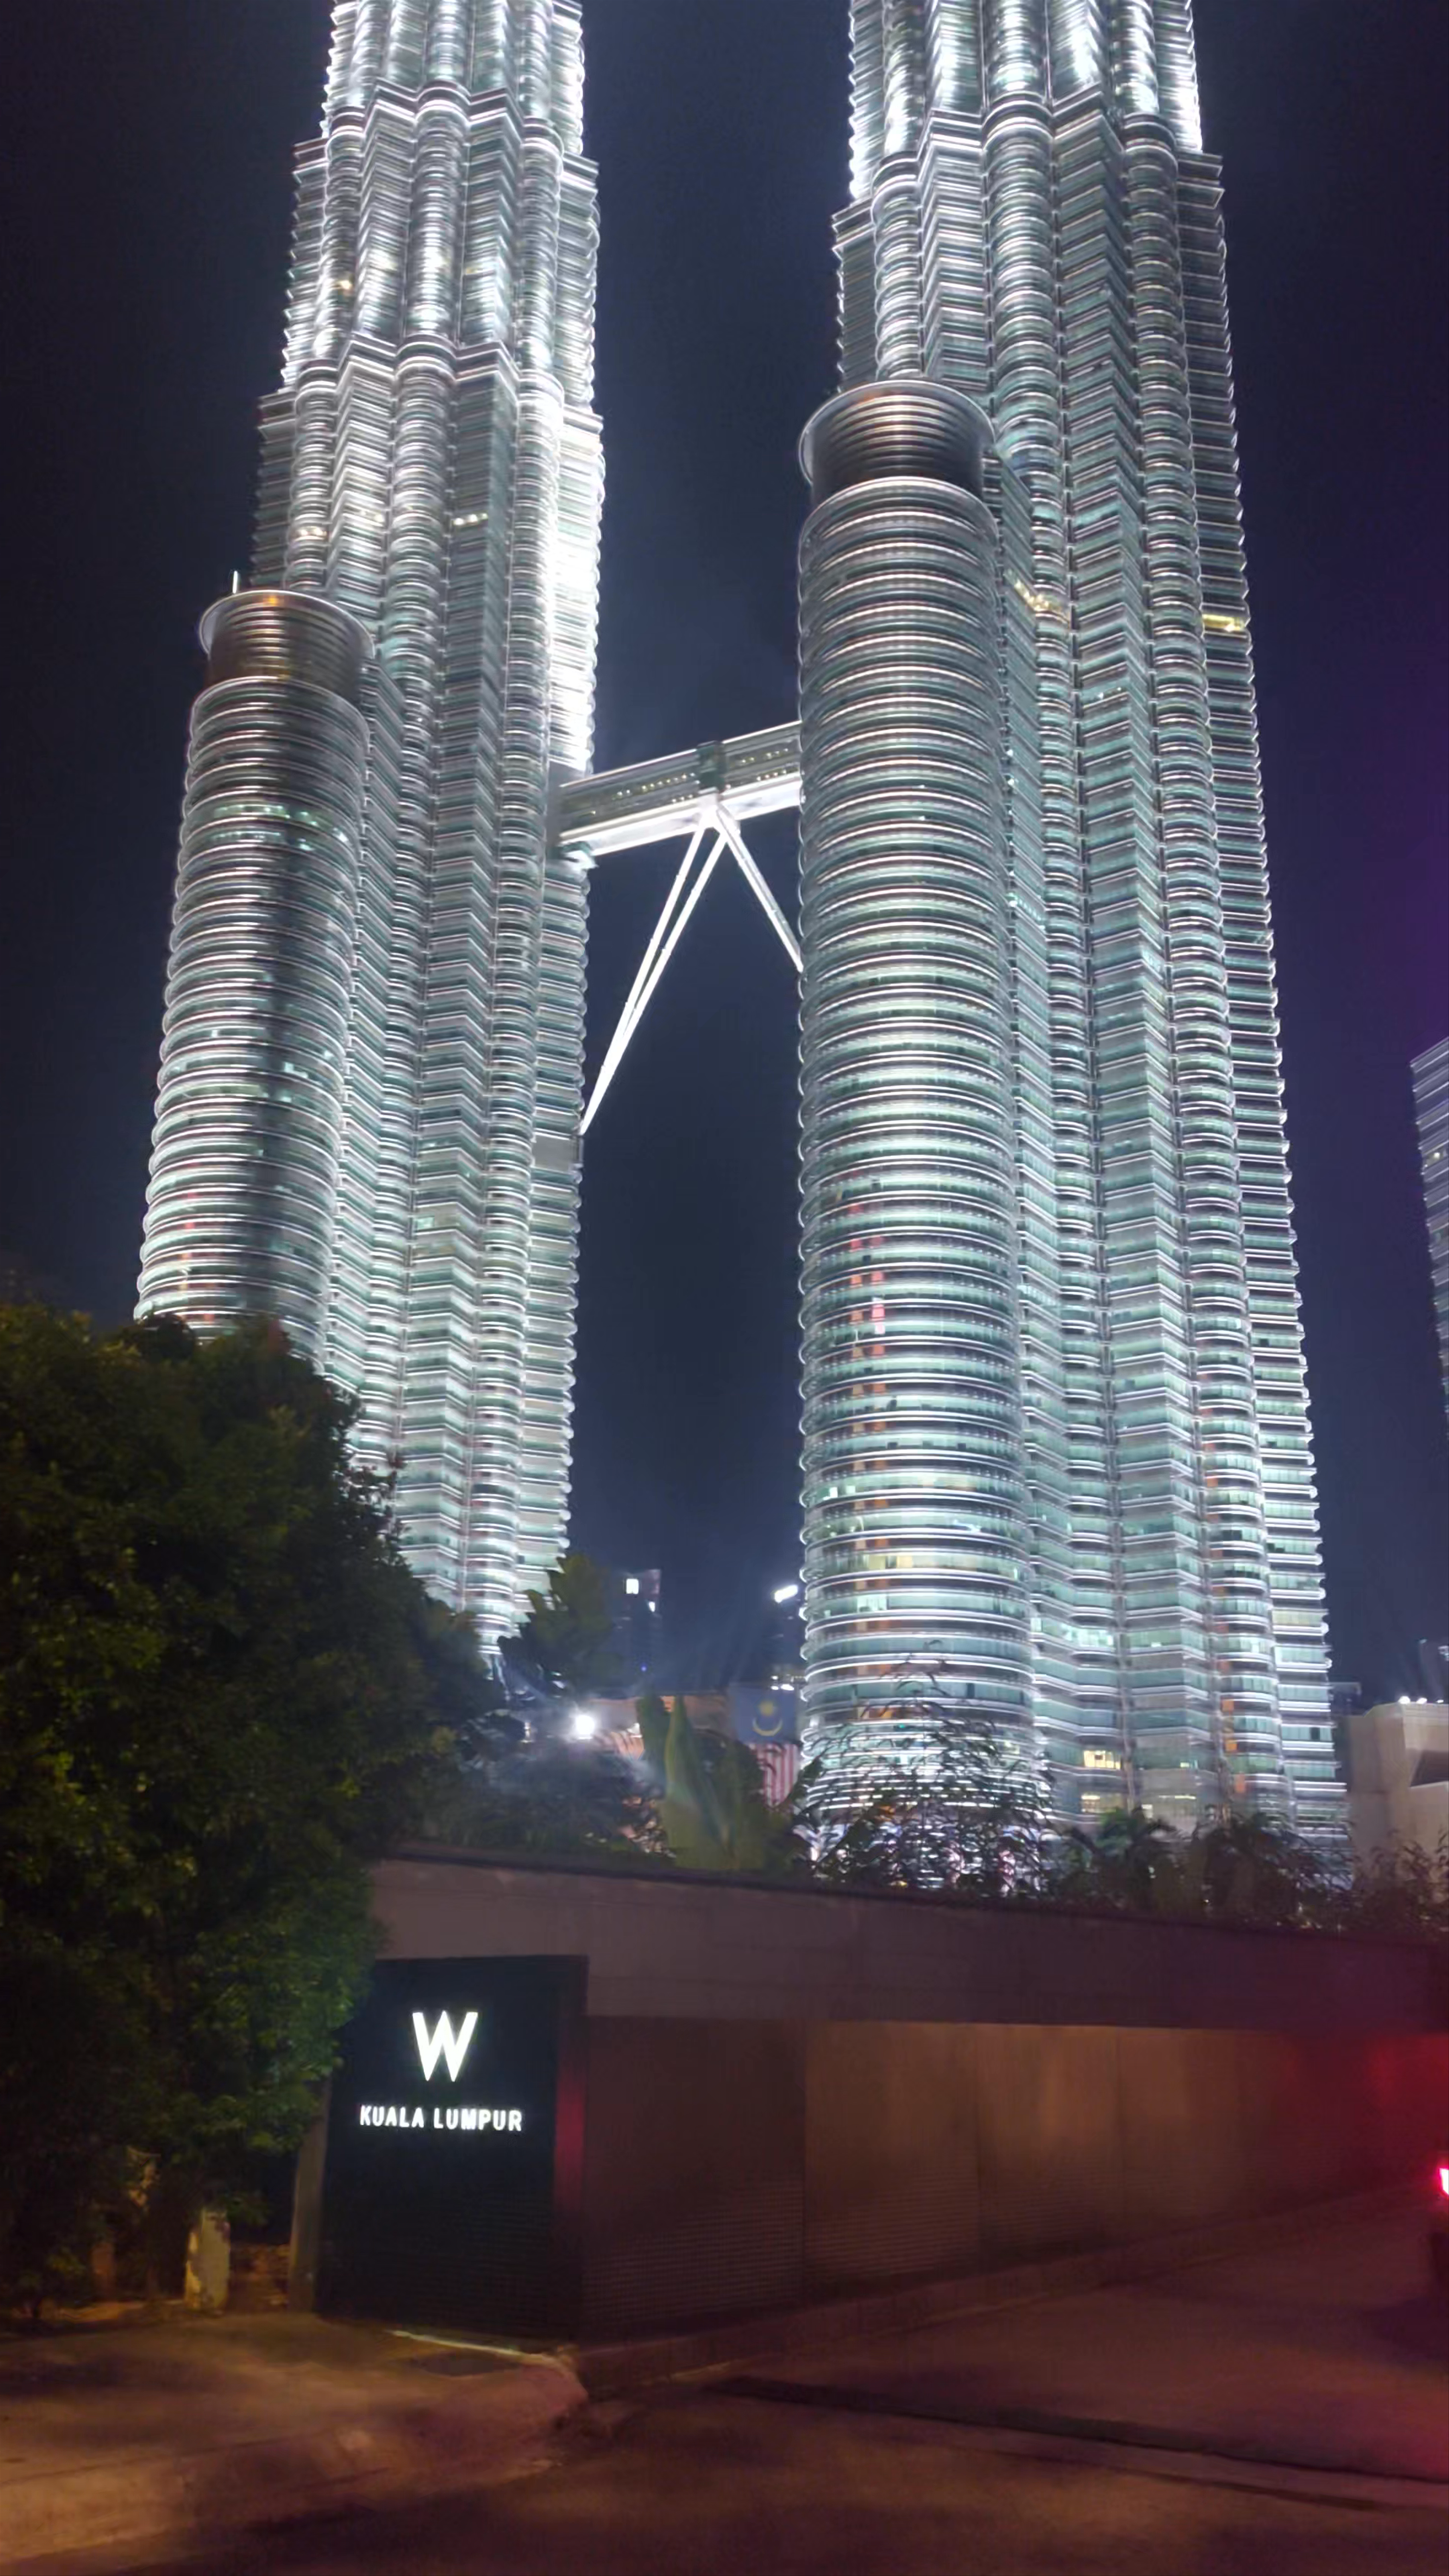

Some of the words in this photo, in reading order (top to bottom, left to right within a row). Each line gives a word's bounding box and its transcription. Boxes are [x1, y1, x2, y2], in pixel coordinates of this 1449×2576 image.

[412, 2010, 478, 2082] W
[360, 2104, 425, 2128] KUALA
[434, 2107, 522, 2131] LUMPUR
